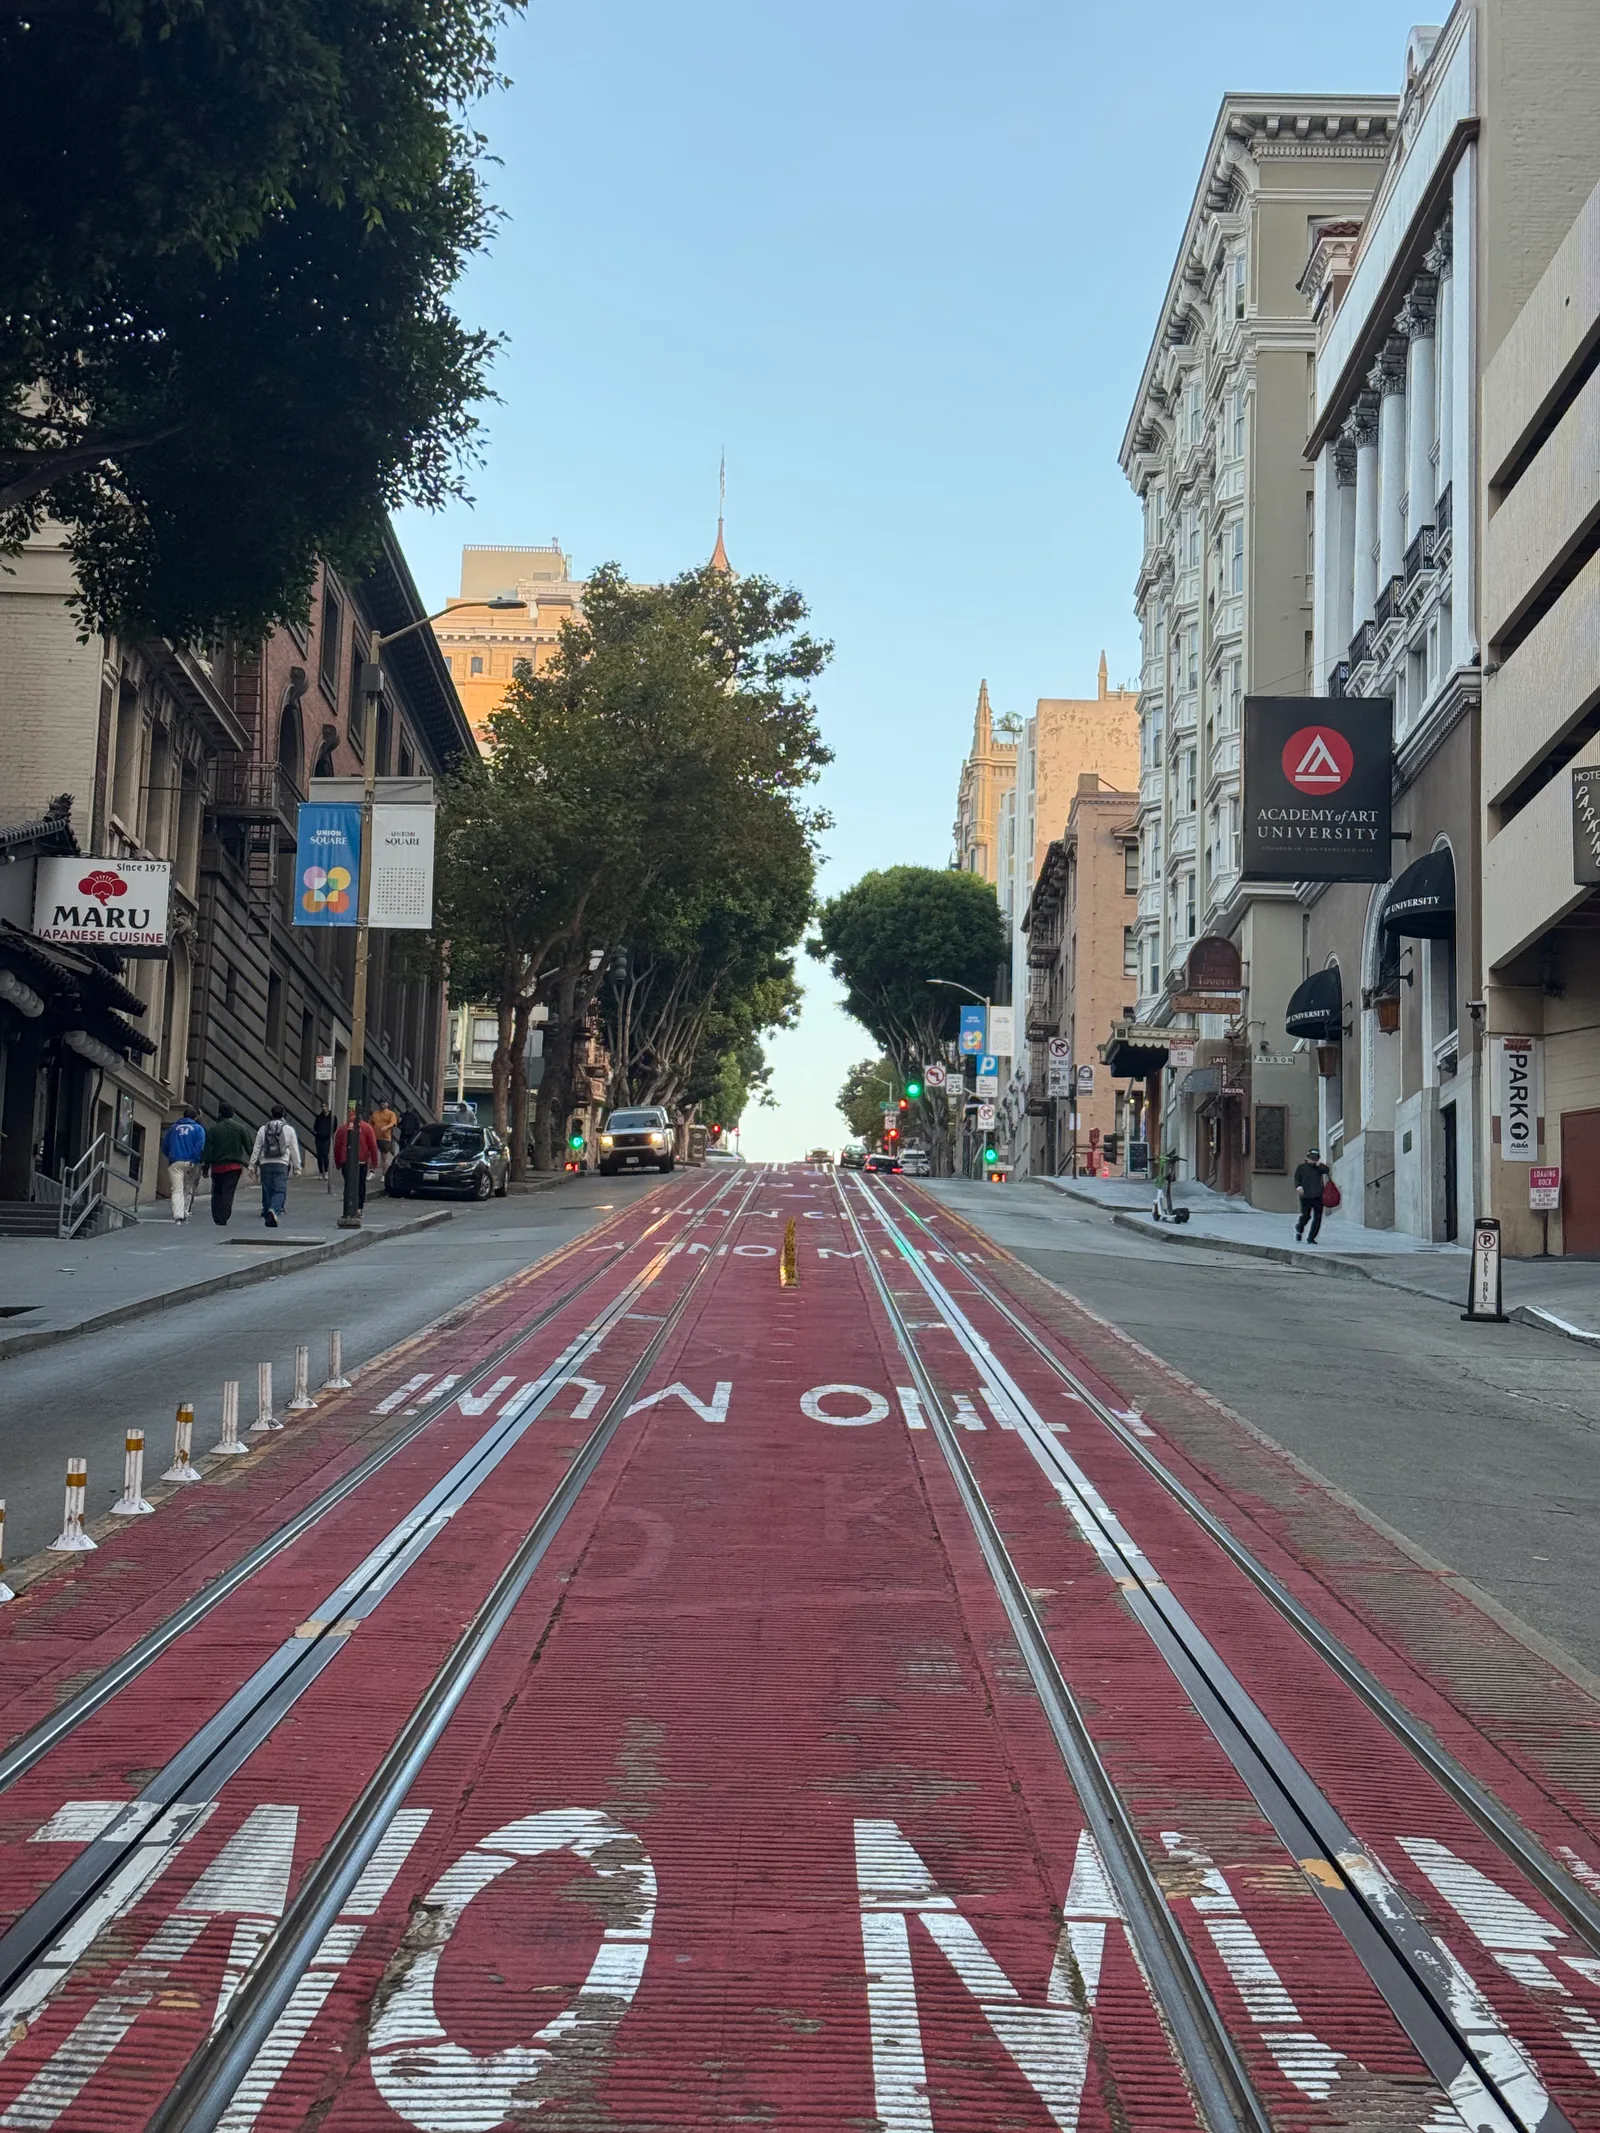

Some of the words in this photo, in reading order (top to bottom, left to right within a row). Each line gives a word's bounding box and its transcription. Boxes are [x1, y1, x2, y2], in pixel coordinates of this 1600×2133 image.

[1574, 772, 1600, 782] HOTE
[1257, 809, 1335, 821] ACADEMY
[1334, 811, 1349, 824] of
[1348, 811, 1379, 822] ART
[316, 829, 342, 837] UNION
[1257, 826, 1379, 840] UNIVERSITY
[310, 836, 348, 846] SQUARE
[385, 837, 421, 846] SQUARE
[117, 863, 142, 872] Since
[145, 864, 168, 873] 1975
[1391, 896, 1440, 912] UNIVERSITY
[52, 905, 151, 929] MARU
[109, 931, 164, 943] CUISINE
[1291, 1009, 1331, 1022] UNIVERSITY
[948, 1085, 961, 1093] 25
[1221, 1087, 1244, 1095] TAVERN
[1509, 1053, 1529, 1120] PARK
[179, 1127, 189, 1136] 34
[1533, 1170, 1556, 1178] LOADING
